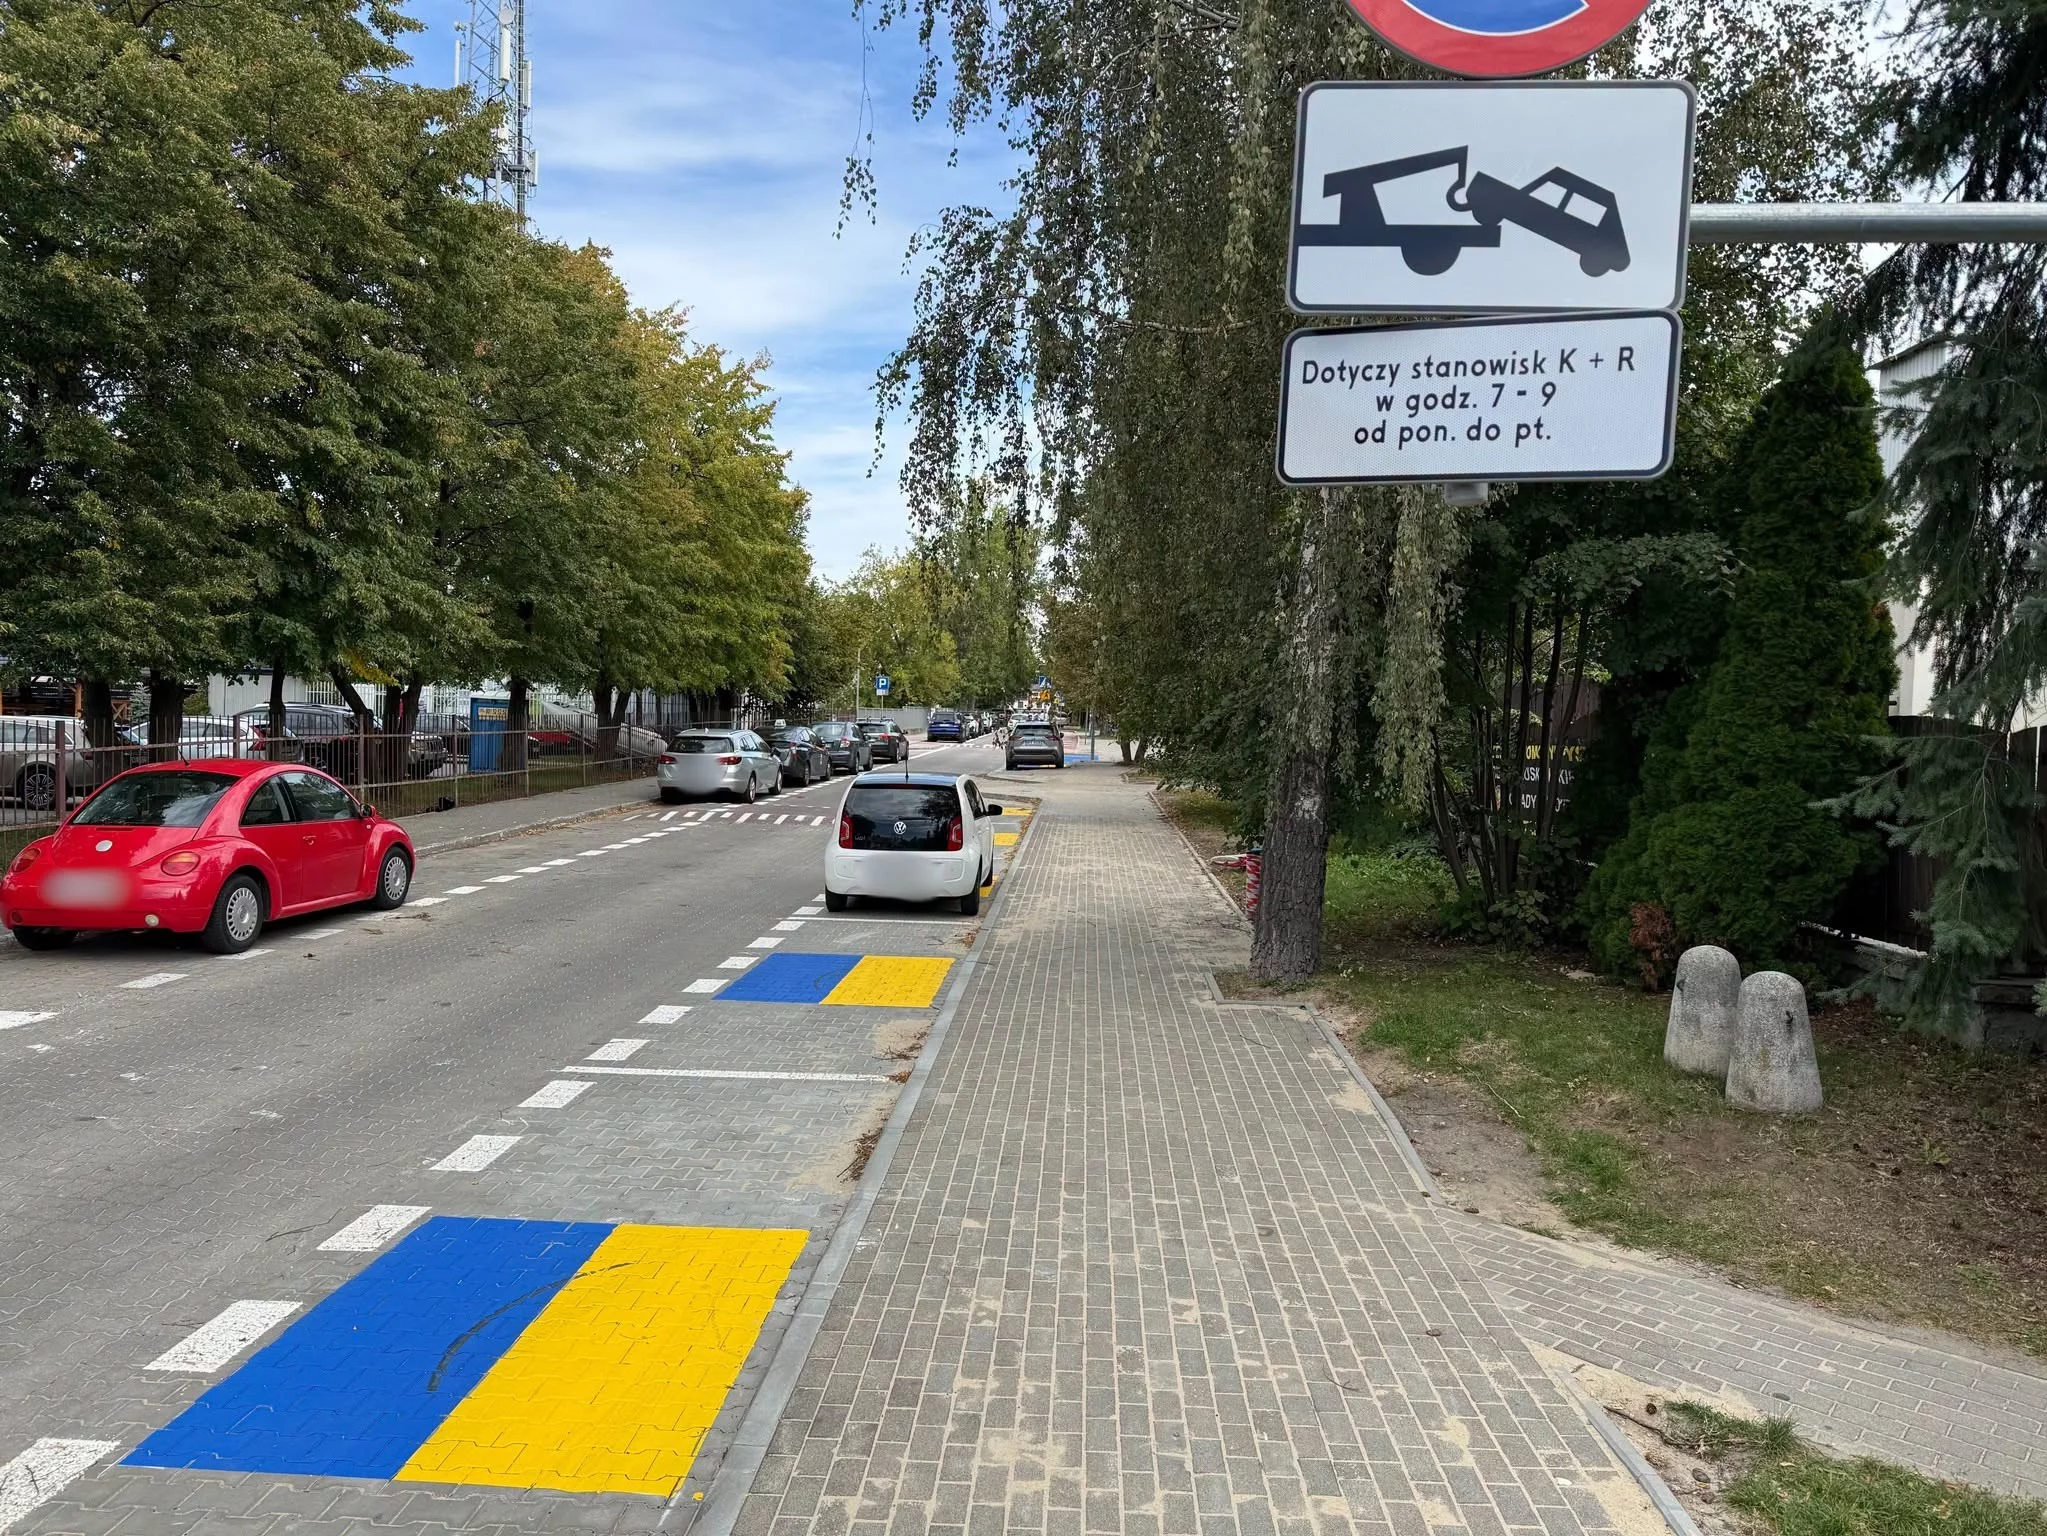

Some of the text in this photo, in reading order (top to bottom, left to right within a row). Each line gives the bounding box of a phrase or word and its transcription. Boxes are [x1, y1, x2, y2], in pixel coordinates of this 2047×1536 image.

[1302, 346, 1635, 390] Dotyczy stanowisk K + R
[1375, 395, 1395, 413] w
[1405, 384, 1478, 419] godz.
[1491, 382, 1506, 408] 7
[1541, 381, 1557, 407] 9
[1354, 416, 1551, 451] od pon. do pt.
[879, 678, 887, 689] P
